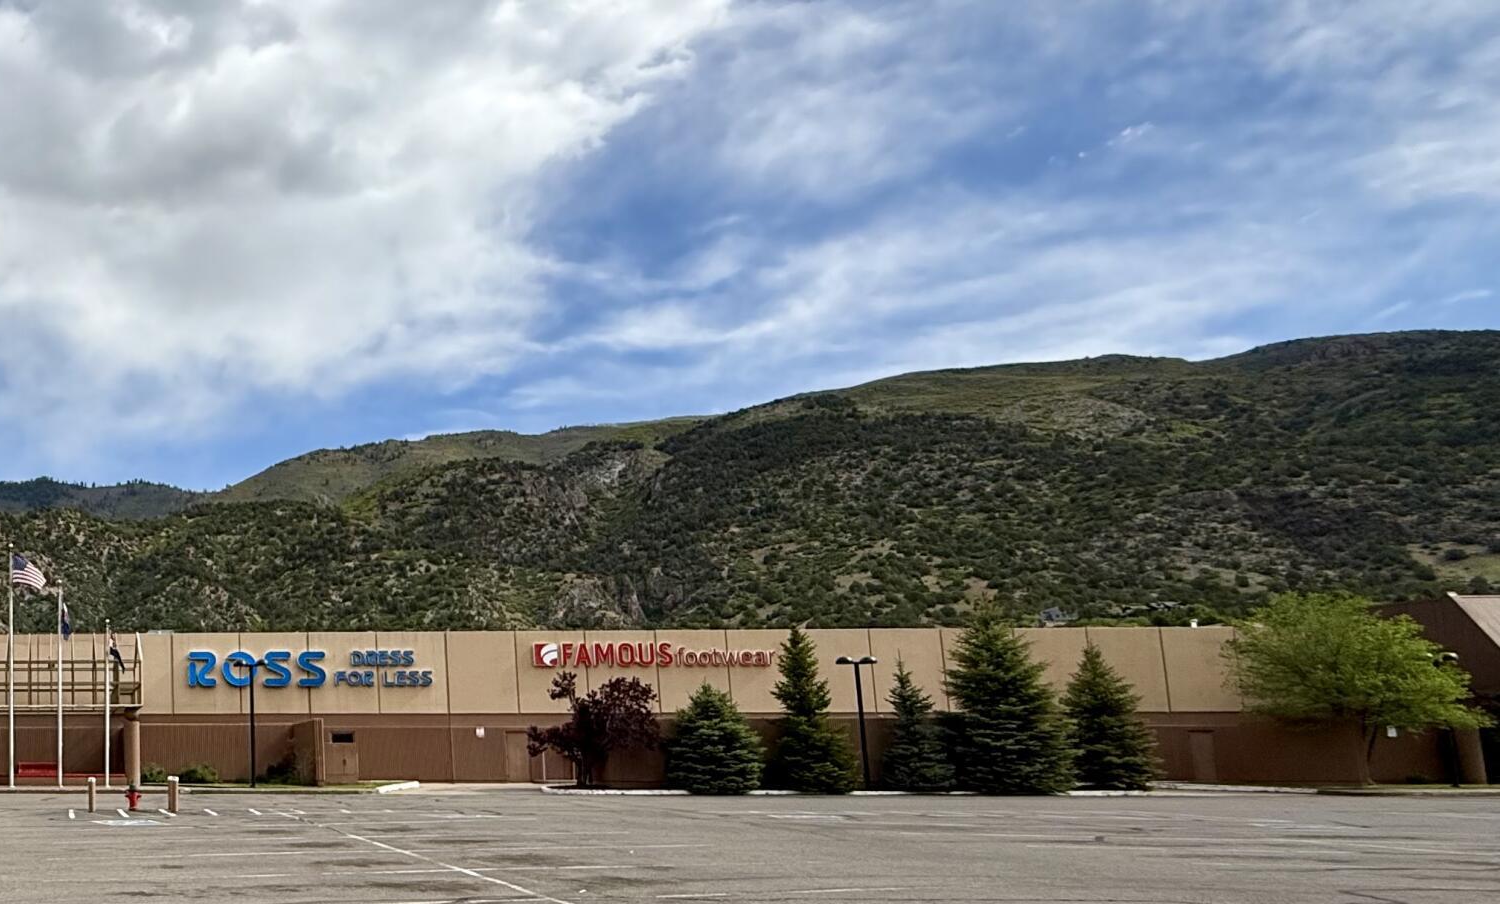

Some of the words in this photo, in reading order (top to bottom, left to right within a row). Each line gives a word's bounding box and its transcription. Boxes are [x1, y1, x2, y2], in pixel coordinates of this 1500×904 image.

[350, 650, 415, 667] DRESS
[560, 642, 674, 668] FAMOUS
[675, 646, 776, 668] footwear
[187, 651, 327, 688] ROSS
[334, 671, 375, 688] FOR
[382, 671, 433, 688] LESS
